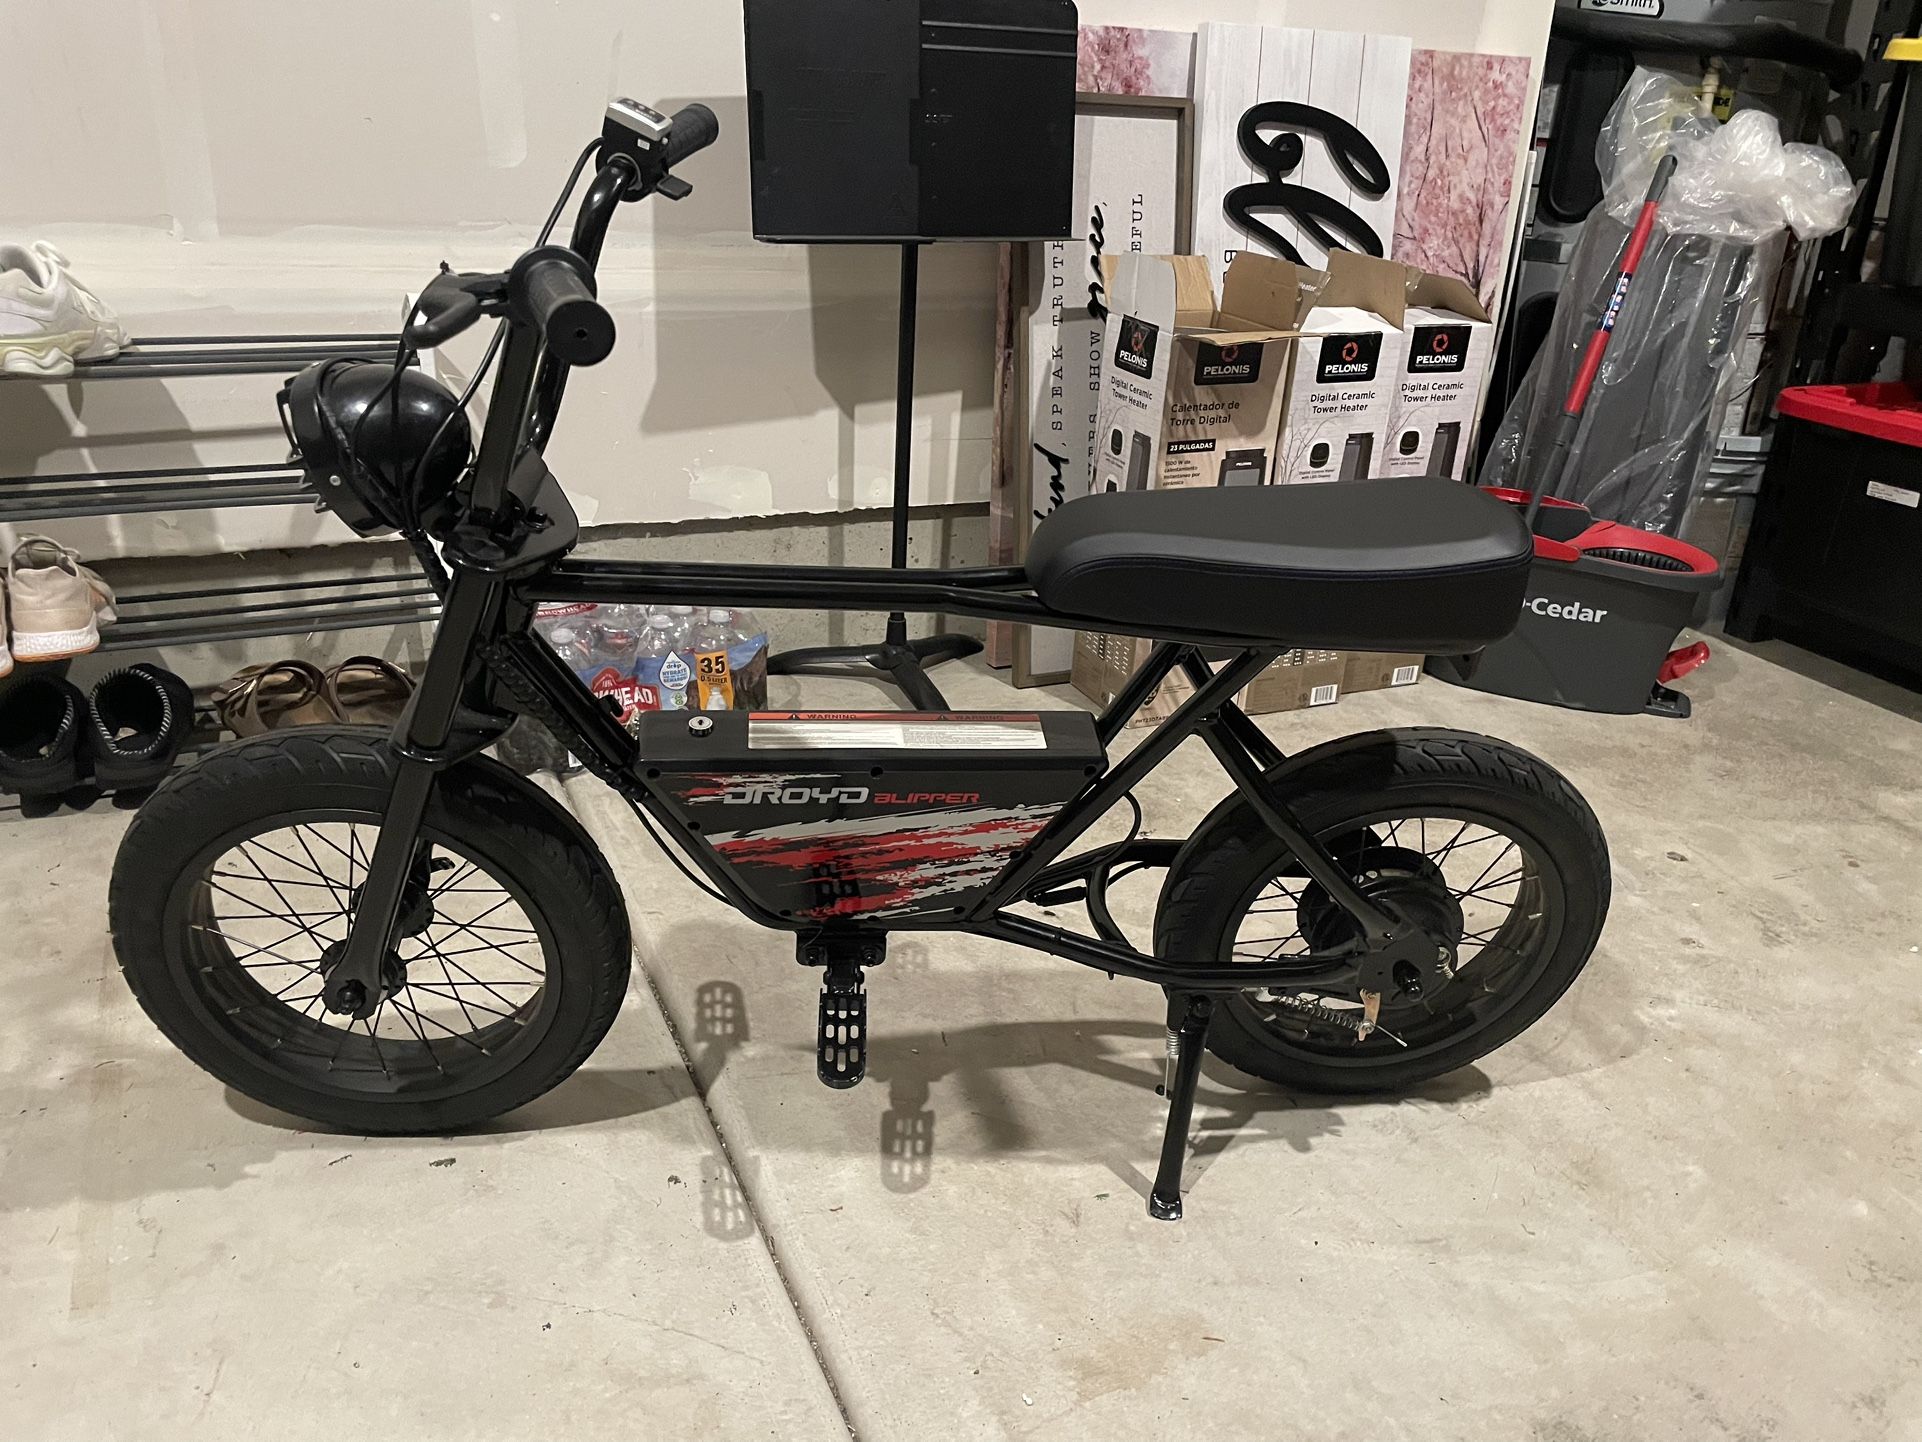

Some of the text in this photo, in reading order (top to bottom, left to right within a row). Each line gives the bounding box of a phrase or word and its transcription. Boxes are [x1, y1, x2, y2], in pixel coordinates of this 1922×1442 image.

[1089, 331, 1101, 391] SHOW
[1119, 350, 1148, 368] PELONIS
[1416, 354, 1458, 364] PELONIS
[1203, 364, 1250, 375] PELONIS
[1324, 363, 1369, 374] PELONIS
[1051, 345, 1063, 431] SPEAK
[1110, 376, 1153, 401] Digital Ceramic
[1401, 381, 1464, 393] Digital Ceramic
[1112, 388, 1148, 411] Tower Heater
[1310, 391, 1376, 403] Digital Ceramic
[1403, 393, 1457, 403] Tower Heater
[1171, 400, 1240, 413] Calentador de
[1312, 403, 1369, 414] Tower Heater
[1170, 414, 1231, 427] Torre Digital
[1178, 442, 1213, 451] PULGADAS
[1522, 597, 1608, 623] -Cedar
[700, 655, 726, 674] 35
[723, 787, 980, 805] DROYD BLIPPER
